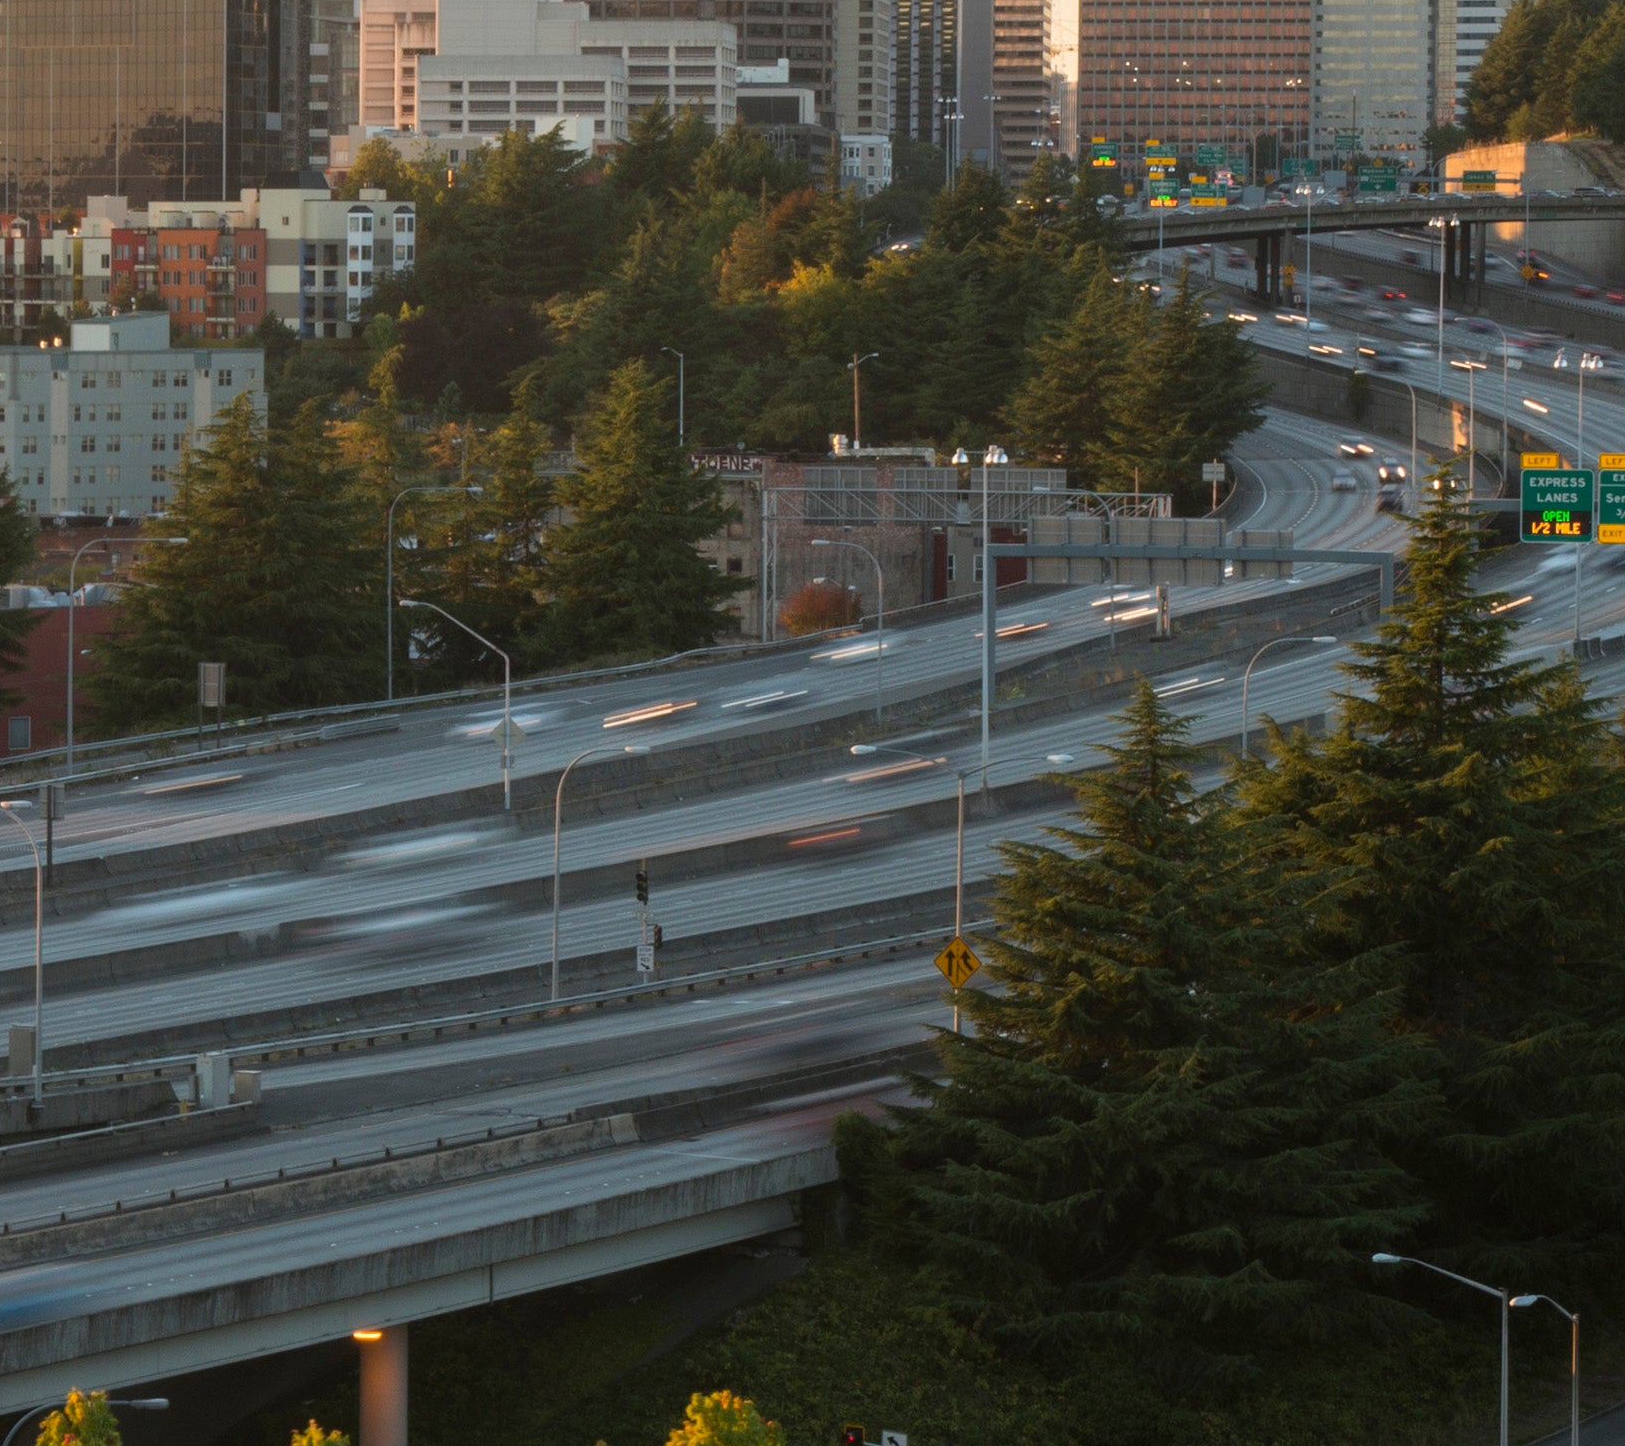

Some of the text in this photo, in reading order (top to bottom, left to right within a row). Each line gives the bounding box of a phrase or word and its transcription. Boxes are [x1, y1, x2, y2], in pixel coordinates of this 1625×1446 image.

[1528, 457, 1550, 465] LEFT
[1529, 477, 1586, 487] EXPRESS
[1537, 493, 1578, 503] LANES
[1542, 511, 1570, 522] OPEN
[1532, 522, 1581, 534] 1/2 MILE
[1602, 529, 1622, 538] EXIT
